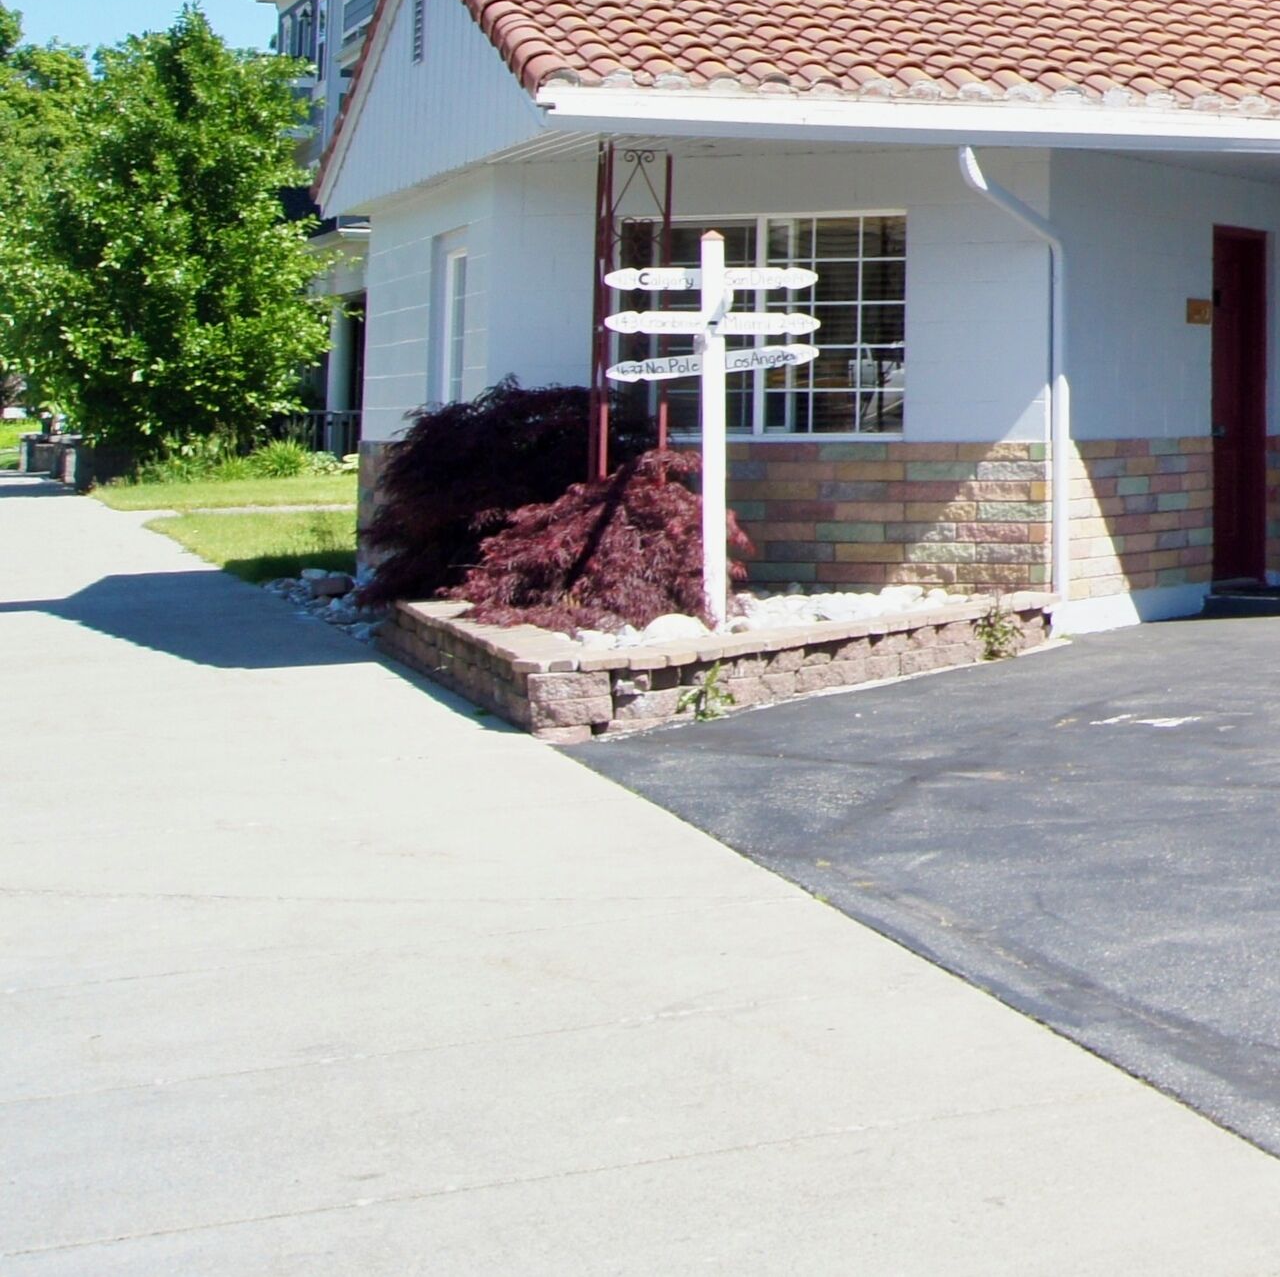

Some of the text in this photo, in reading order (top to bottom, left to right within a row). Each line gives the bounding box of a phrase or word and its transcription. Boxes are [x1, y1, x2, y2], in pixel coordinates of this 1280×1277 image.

[637, 271, 694, 289] Calgary
[750, 269, 791, 287] Diego
[668, 357, 700, 372] Pole
[725, 351, 749, 370] Los
[750, 351, 795, 367] Angeles
